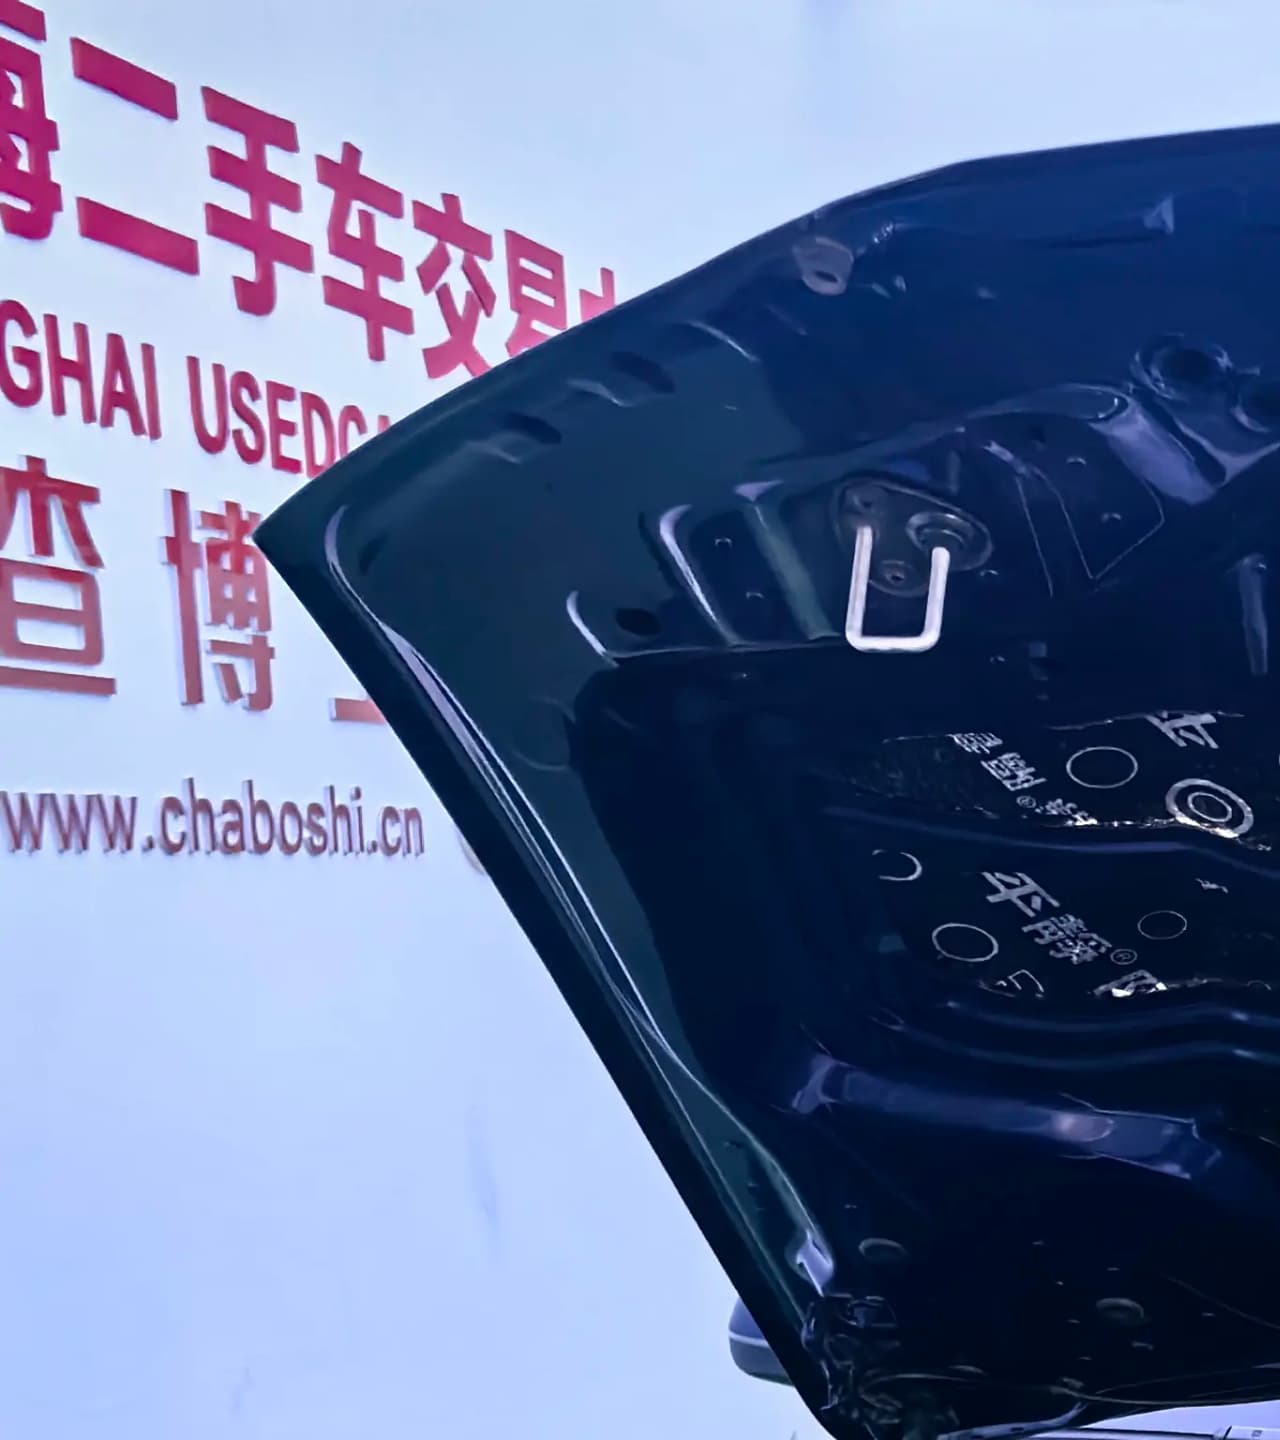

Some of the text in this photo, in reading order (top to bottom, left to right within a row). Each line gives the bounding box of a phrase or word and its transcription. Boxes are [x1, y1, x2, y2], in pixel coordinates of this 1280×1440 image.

[0, 0, 616, 380] 二手车交易
[186, 355, 391, 478] USEDC
[0, 454, 386, 723] 查博
[0, 777, 425, 856] www.chaboshi.cn
